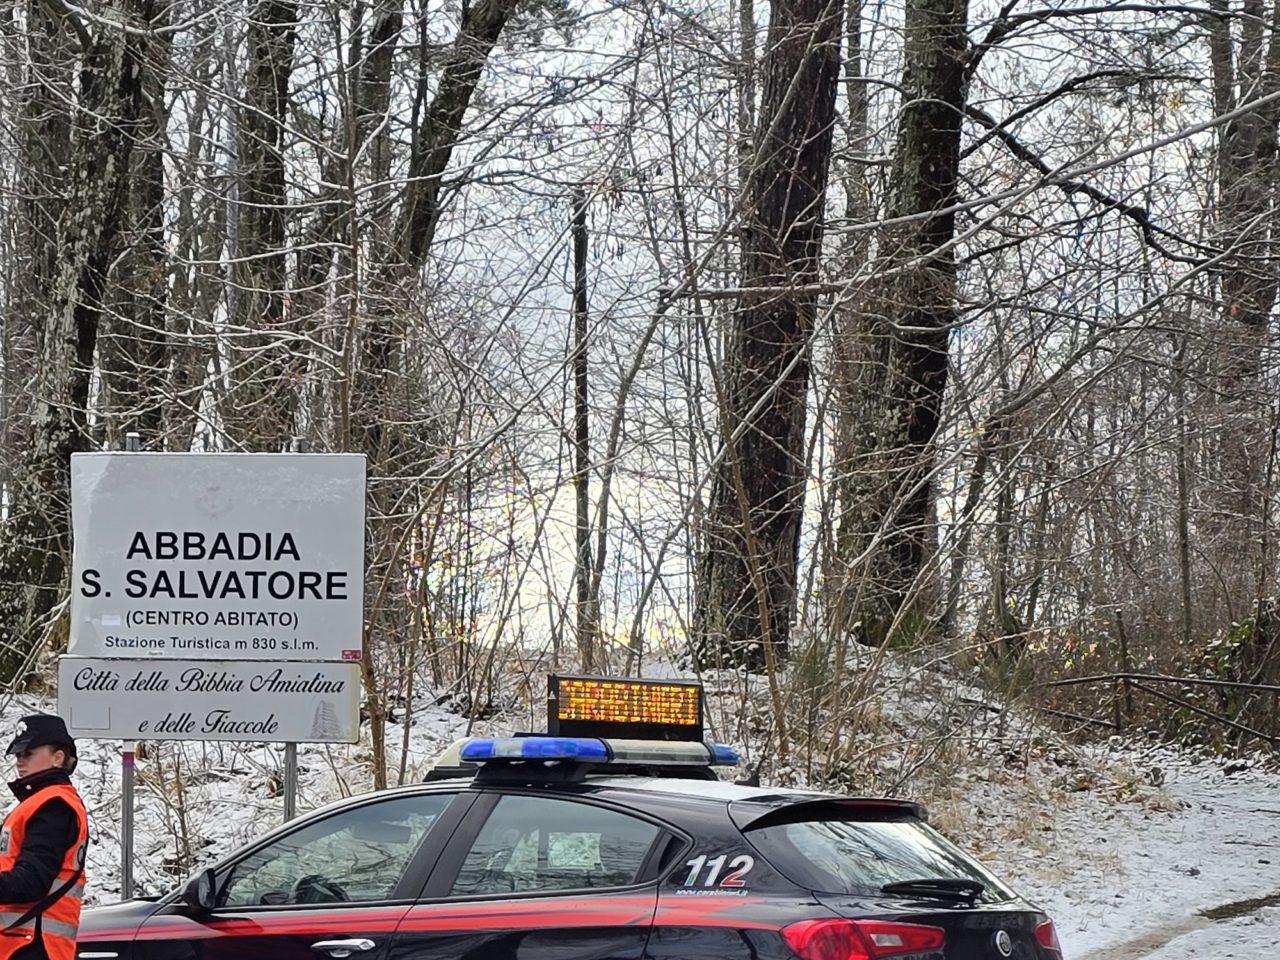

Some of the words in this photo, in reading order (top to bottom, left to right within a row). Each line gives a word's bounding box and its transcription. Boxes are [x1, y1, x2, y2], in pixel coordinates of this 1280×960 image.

[126, 531, 300, 560] ABBADIA
[80, 569, 111, 598] S.
[125, 569, 348, 600] SALVATORE
[126, 610, 209, 628] (CENTRO
[213, 611, 299, 630] ABITATO)
[104, 635, 166, 649] Stazione
[169, 636, 230, 650] Turistica
[234, 640, 247, 650] m
[252, 639, 276, 650] 830
[281, 640, 319, 651] s.l.m.
[73, 667, 120, 692] Città
[124, 670, 170, 692] della
[175, 667, 244, 693] Bibbia
[249, 668, 345, 694] Amiatina
[138, 720, 149, 733] e
[153, 712, 196, 733] delle
[200, 709, 279, 734] Fiaccole
[684, 854, 755, 887] 112
